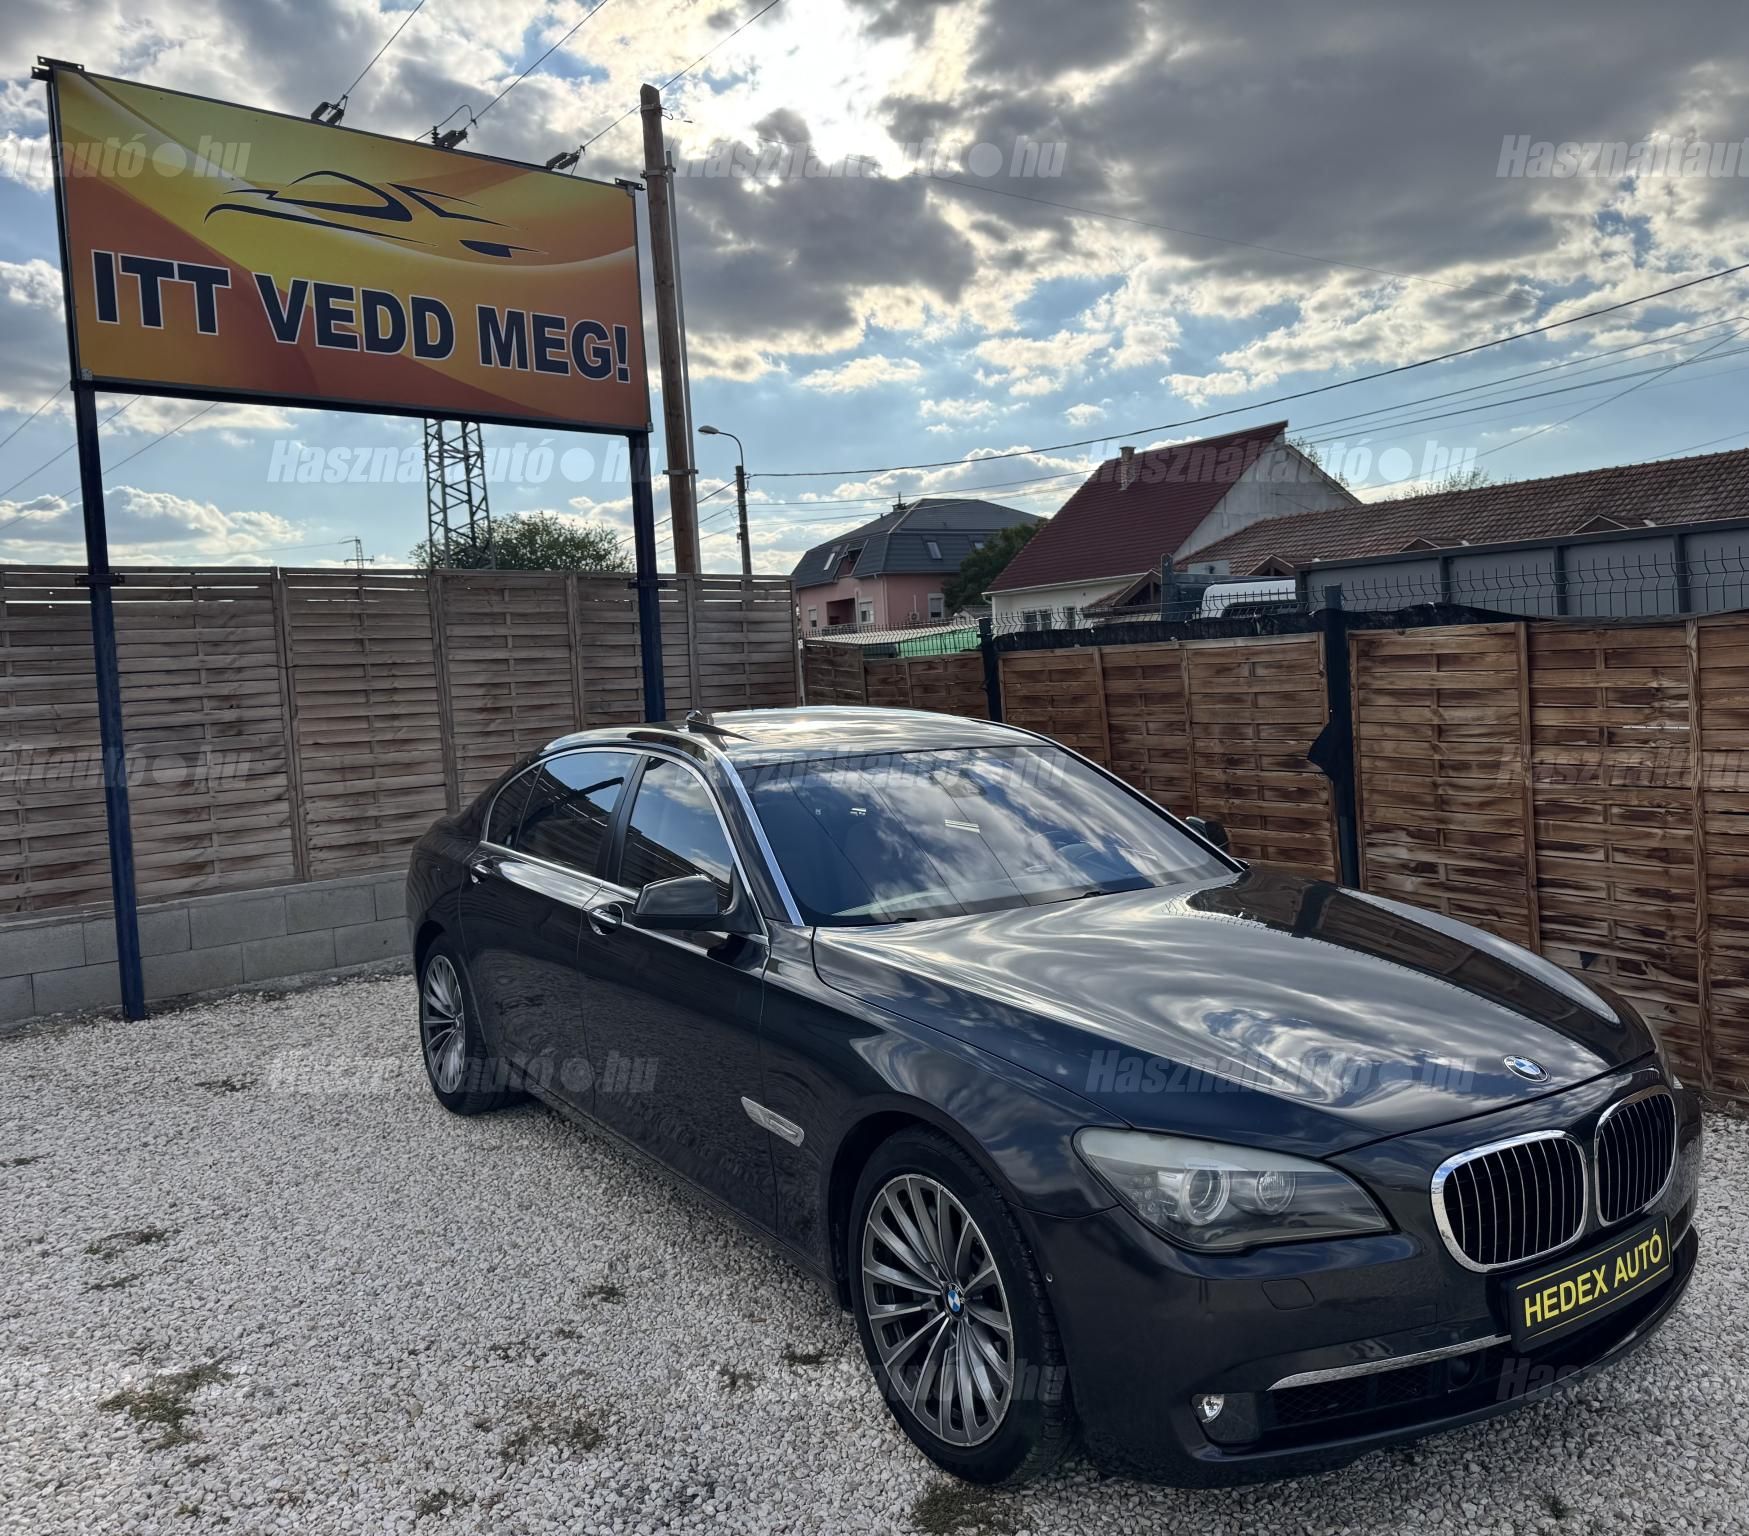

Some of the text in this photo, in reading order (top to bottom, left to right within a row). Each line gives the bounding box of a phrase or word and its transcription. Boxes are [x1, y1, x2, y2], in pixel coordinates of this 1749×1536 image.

[91, 249, 631, 384] ITT VEDD MEG!
[1524, 1228, 1663, 1327] HEDEX AUTÓ
